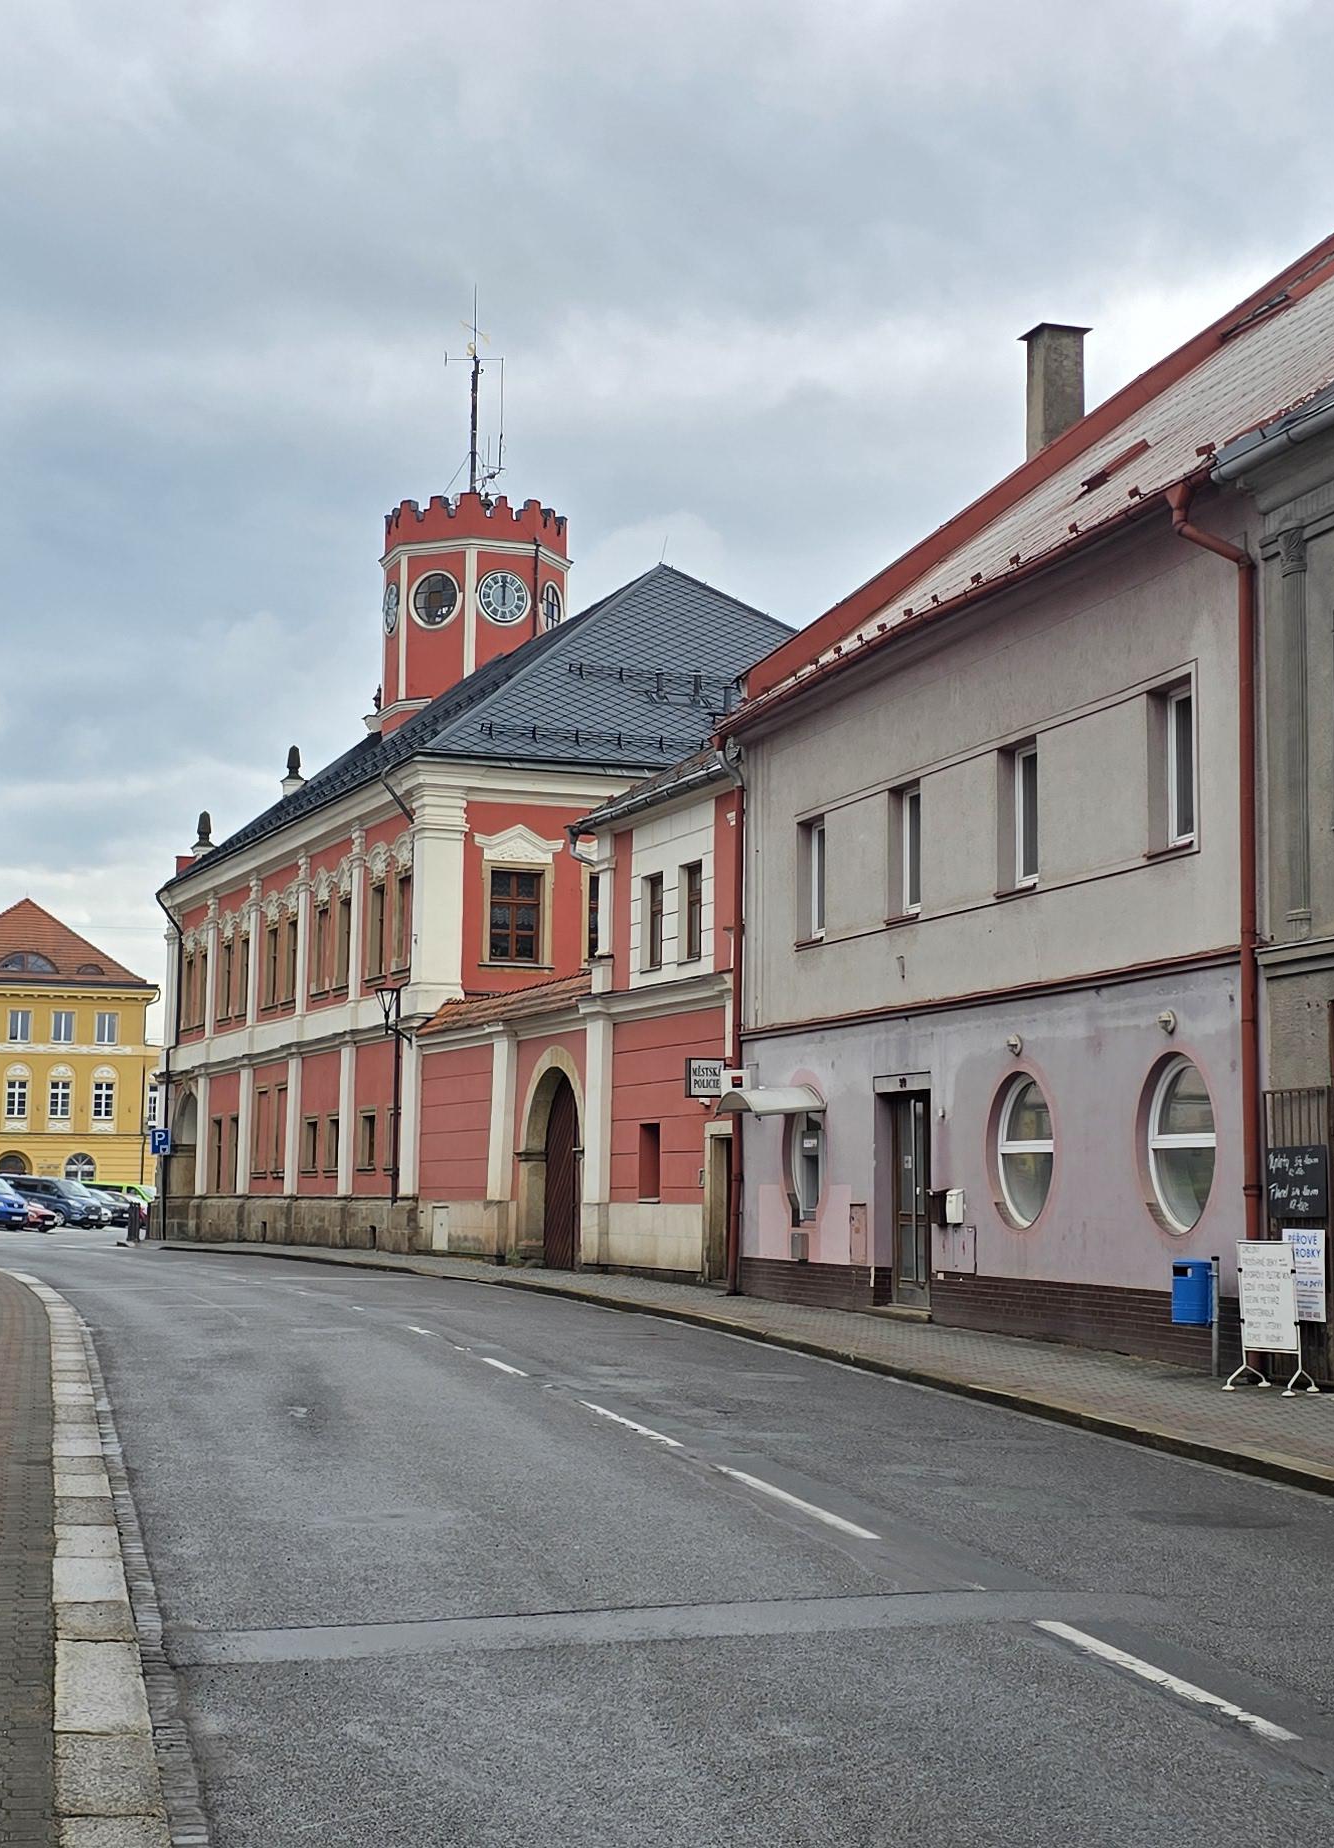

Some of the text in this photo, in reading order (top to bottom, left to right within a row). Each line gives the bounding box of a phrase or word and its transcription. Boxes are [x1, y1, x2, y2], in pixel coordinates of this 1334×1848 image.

[694, 1079, 720, 1089] POLICIE
[155, 1132, 166, 1146] P
[1295, 1248, 1321, 1258] ROBKY
